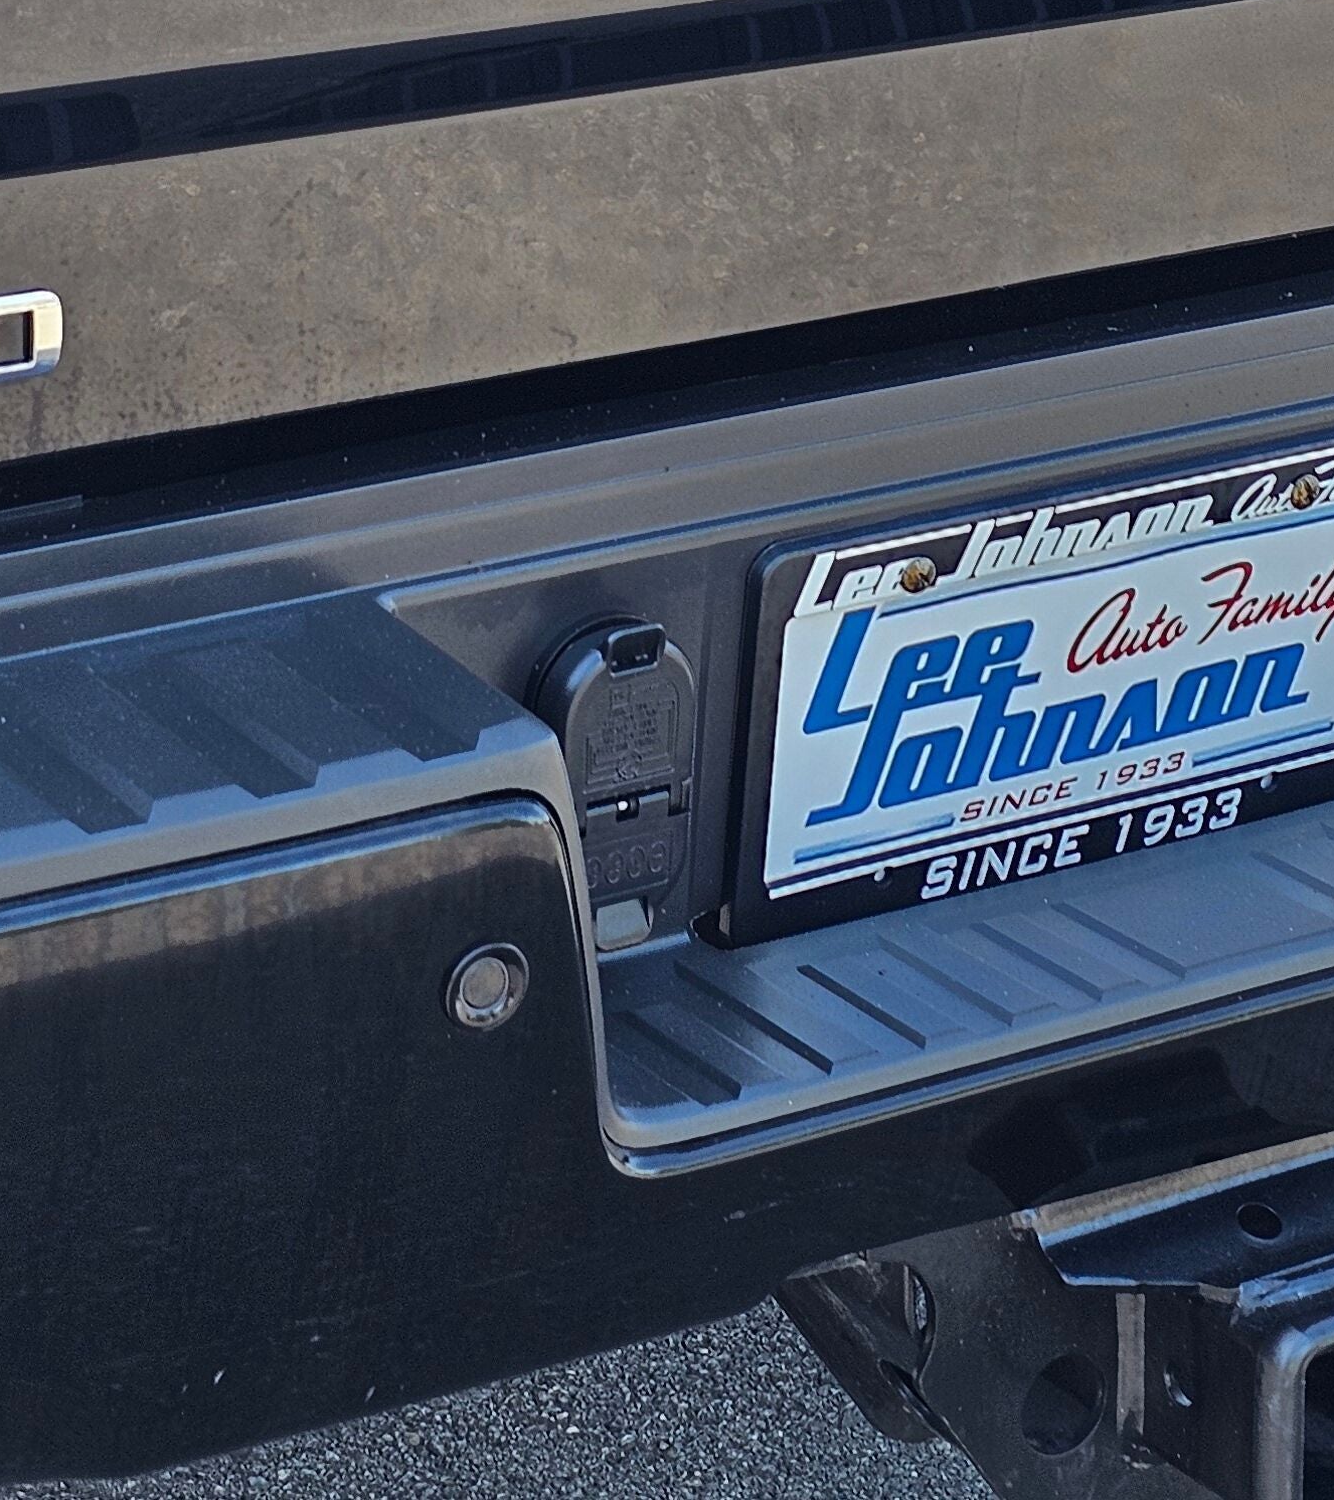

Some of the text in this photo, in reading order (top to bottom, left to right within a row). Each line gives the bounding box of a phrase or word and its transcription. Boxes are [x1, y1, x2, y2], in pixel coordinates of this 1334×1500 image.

[935, 494, 1215, 584] Johnson
[1230, 473, 1317, 523] Aut
[803, 606, 1041, 735] Lee
[1066, 588, 1188, 674] Auto
[804, 642, 1310, 827] Johnson
[959, 751, 1187, 823] SINCE 1933
[920, 786, 1244, 900] SINCE 1933
